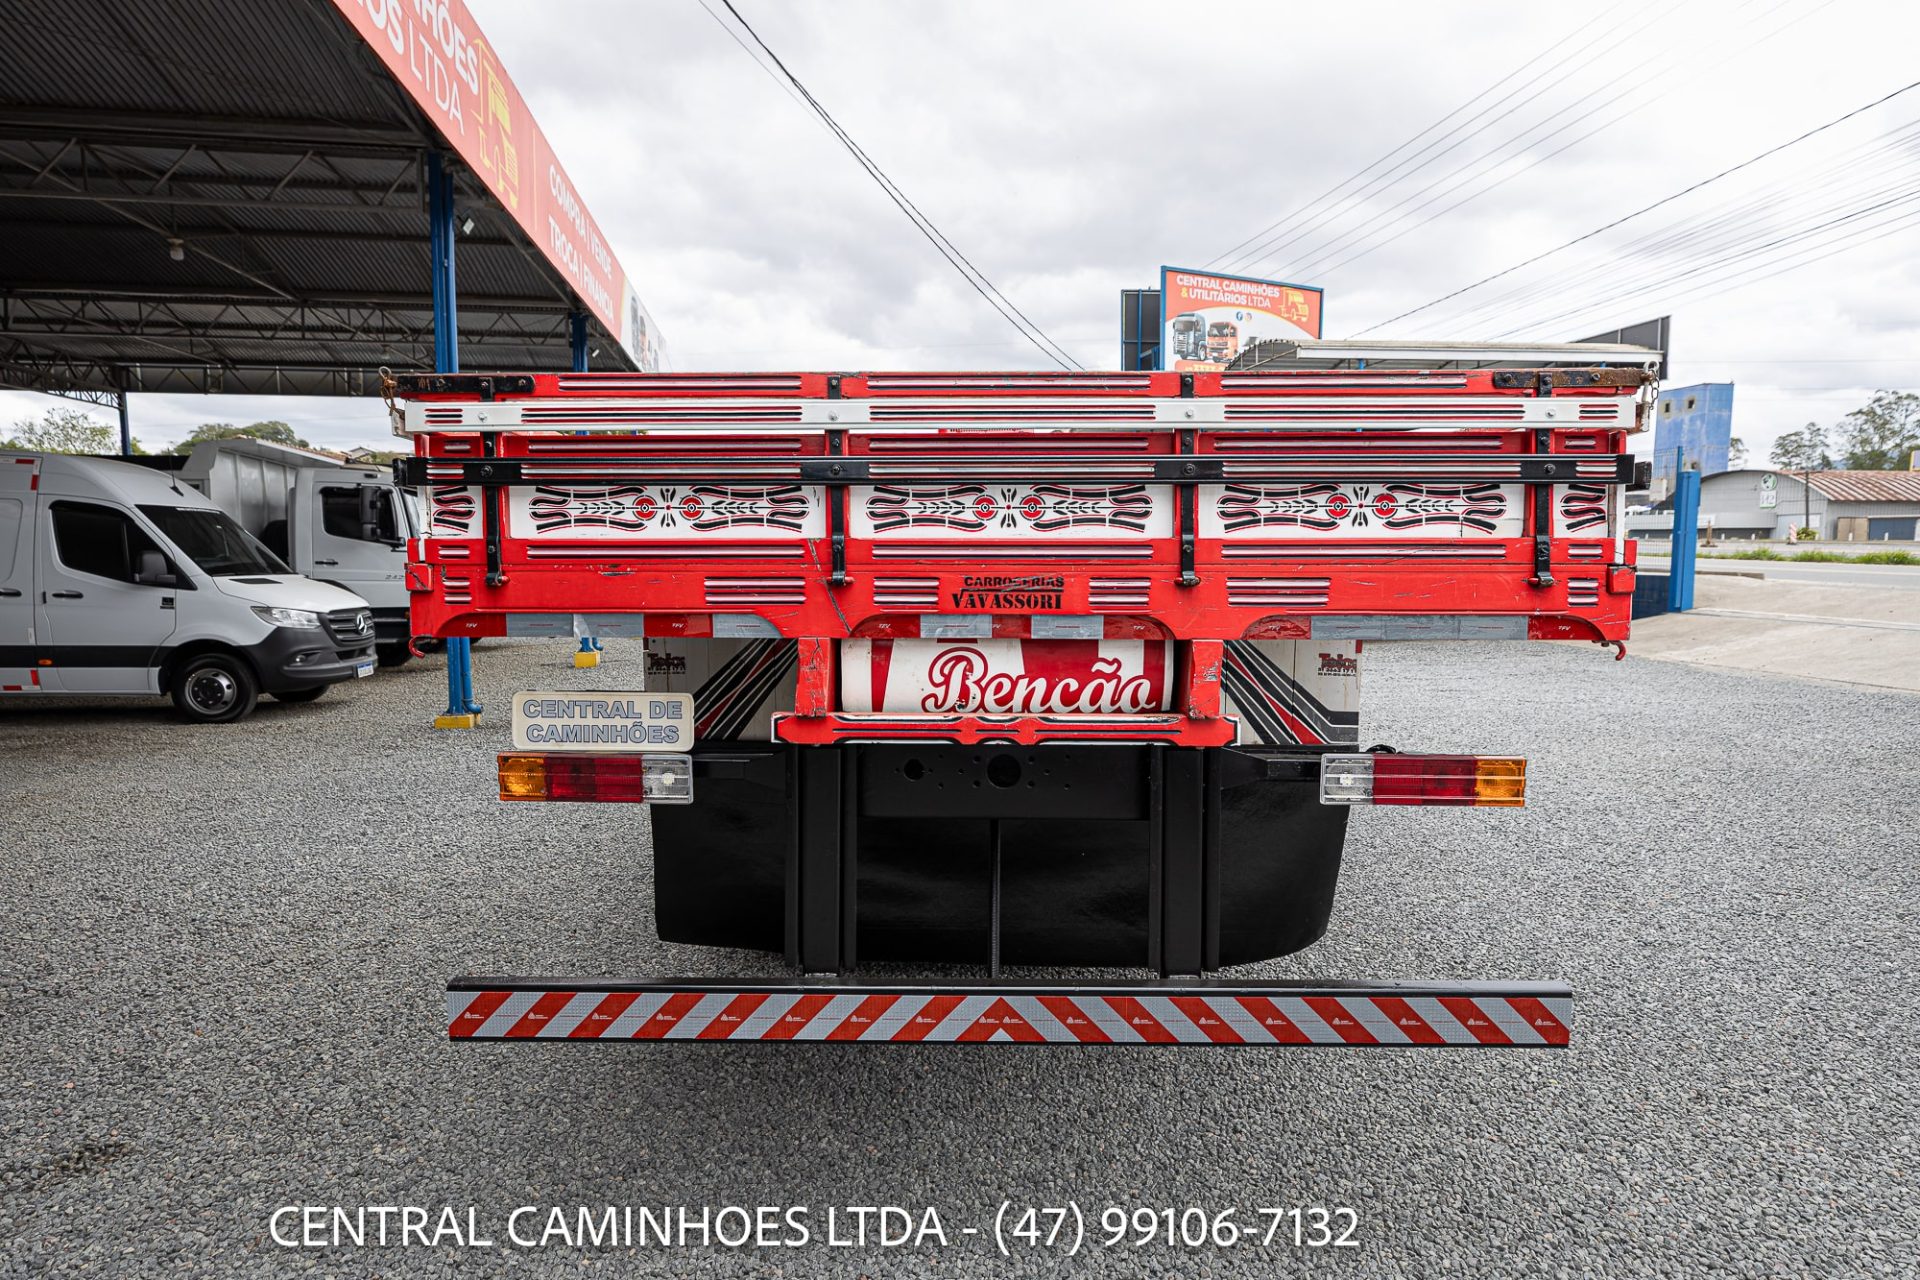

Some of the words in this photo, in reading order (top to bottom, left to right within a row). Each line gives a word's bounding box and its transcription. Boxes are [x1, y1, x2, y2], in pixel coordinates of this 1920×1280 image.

[413, 0, 479, 97] HÕES
[408, 17, 466, 137] LTDA
[549, 164, 587, 242] COMPRA
[589, 226, 613, 281] VENDE
[548, 214, 580, 281] TROCA
[1176, 274, 1221, 290] CENTRAL
[1222, 280, 1281, 298] CAMINHÕES
[1180, 287, 1188, 299] &
[1189, 287, 1248, 305] UTILITÁRIOS
[1247, 296, 1272, 309] LTDA
[952, 592, 1062, 610] VAVASSORI
[522, 699, 642, 719] CENTRAL
[649, 700, 683, 719] DE
[526, 721, 680, 744] CAMINHÕES
